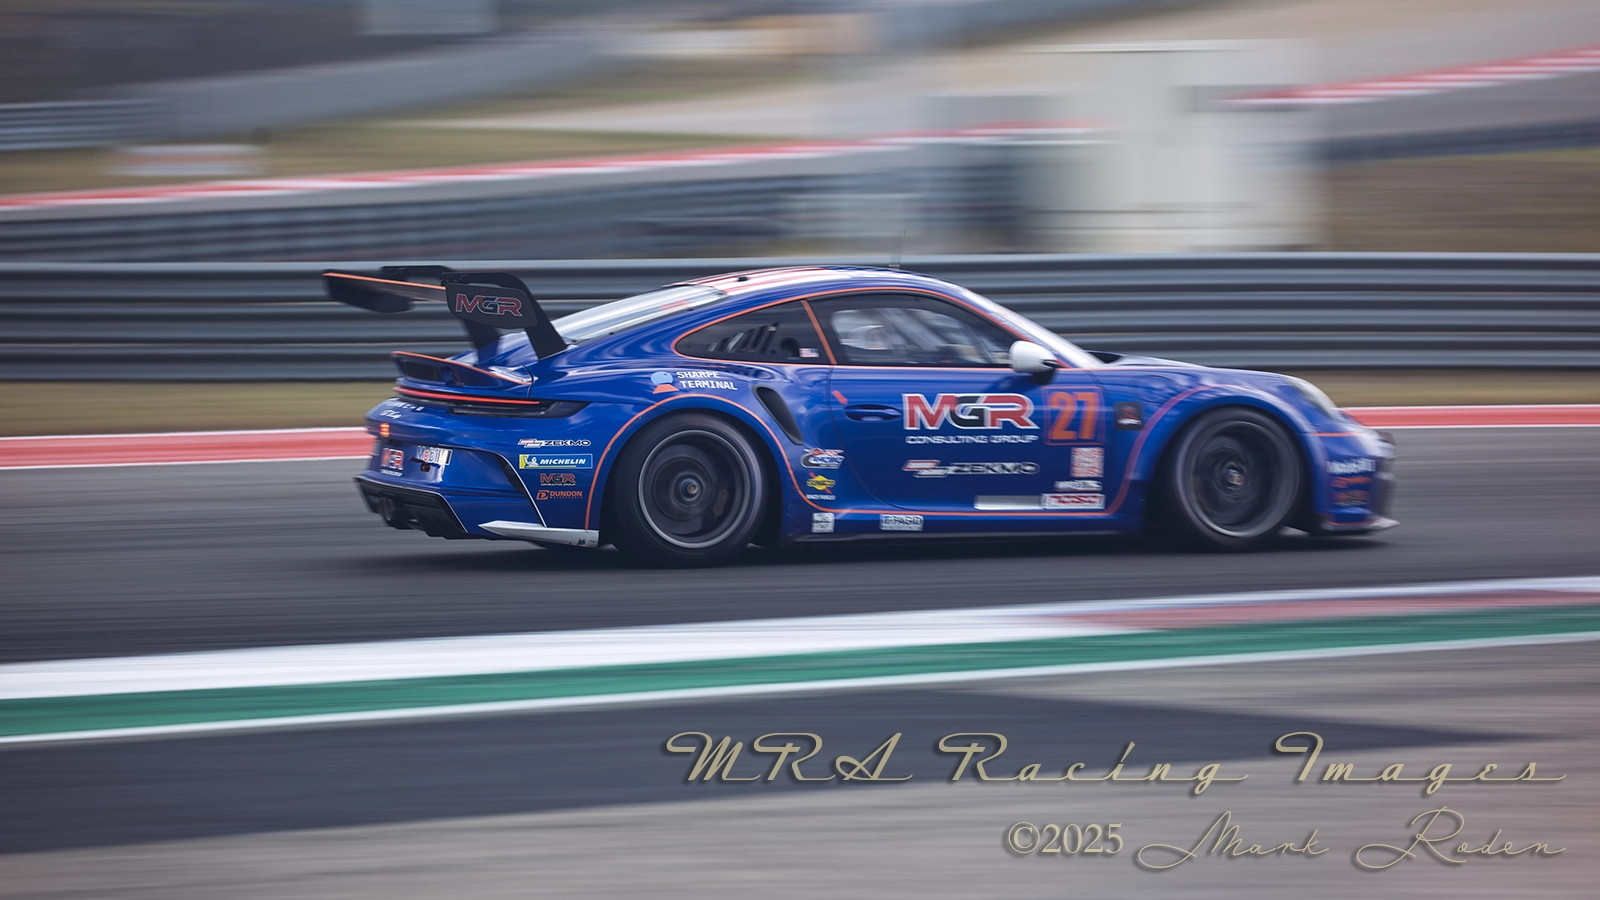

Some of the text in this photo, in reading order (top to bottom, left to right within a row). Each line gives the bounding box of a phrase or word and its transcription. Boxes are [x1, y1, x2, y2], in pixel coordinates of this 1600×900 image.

[455, 293, 523, 317] MGR
[675, 371, 721, 379] SHARPE
[680, 380, 738, 391] TERMINAL
[902, 393, 1041, 430] MGR
[1048, 391, 1100, 440] 27
[543, 439, 592, 447] ZEKMO
[905, 434, 1039, 444] CONSULTING GROUP
[950, 461, 1041, 475] ZEKMO
[540, 472, 576, 483] MGR
